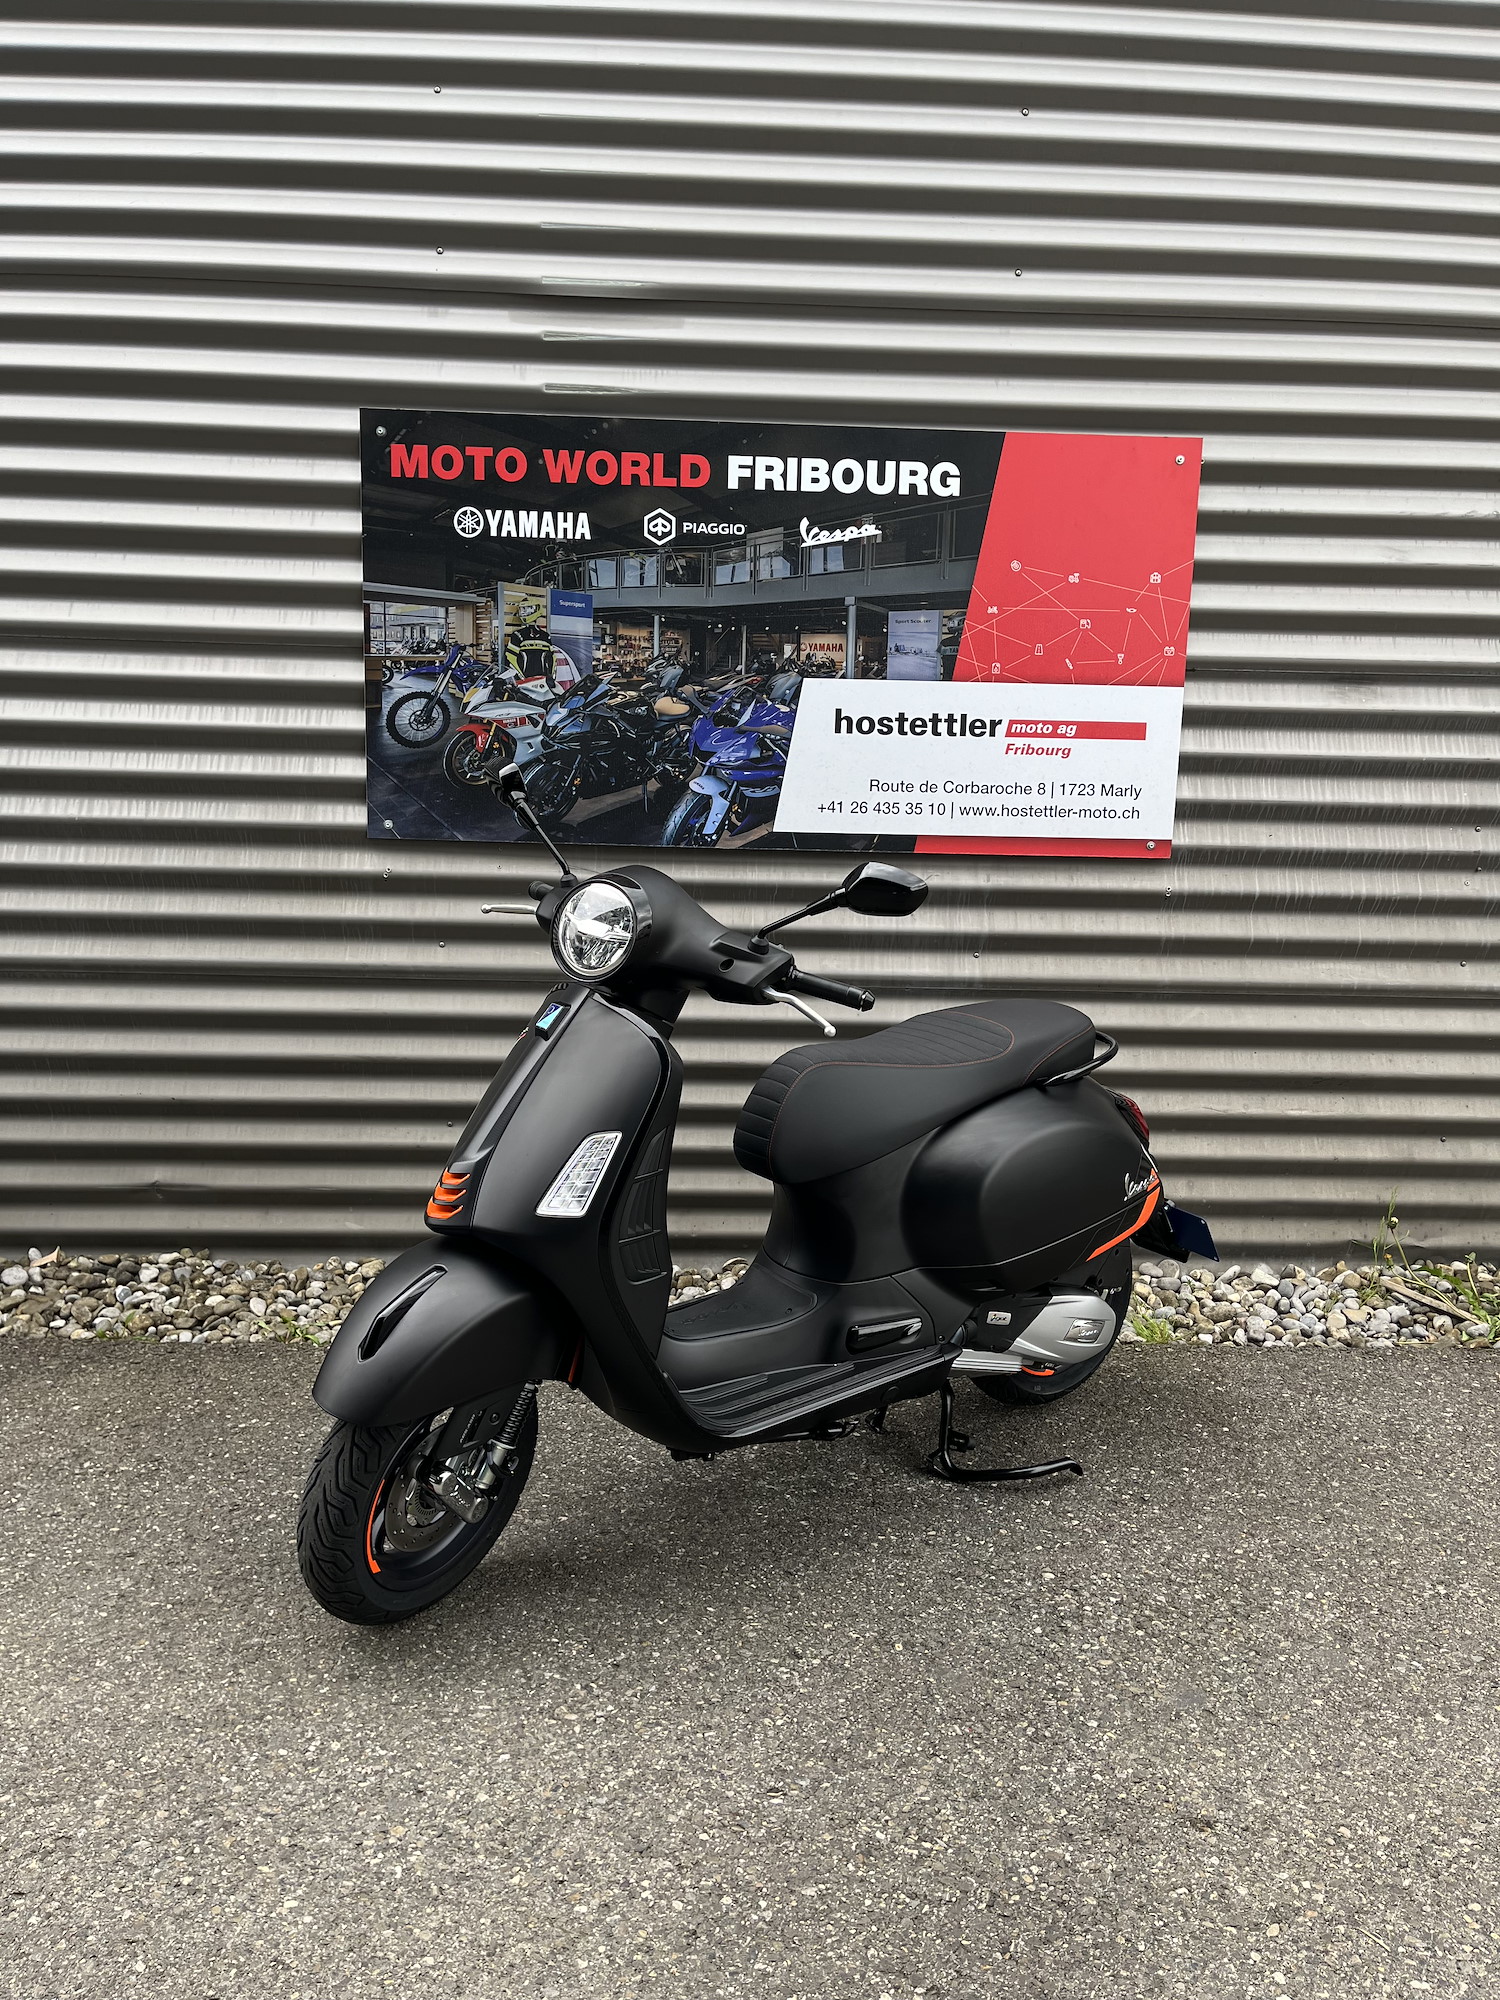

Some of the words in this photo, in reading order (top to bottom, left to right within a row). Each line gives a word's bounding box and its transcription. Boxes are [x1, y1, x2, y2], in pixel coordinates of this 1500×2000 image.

[390, 443, 528, 483] MOTO
[542, 449, 711, 488] WORLD
[727, 455, 961, 498] FRIBOURG
[484, 509, 592, 540] YAMAHA
[682, 522, 745, 535] PIAGGIO
[799, 516, 882, 547] Vespa
[559, 599, 586, 608] Supersport
[807, 643, 844, 653] YAMAHA
[834, 708, 1003, 738] hostettler
[1010, 722, 1053, 734] moto
[1056, 724, 1078, 737] ag
[1004, 743, 1072, 759] Fribourg
[869, 778, 915, 793] Route
[919, 780, 939, 794] de
[943, 780, 1033, 796] Corbaroche
[1036, 782, 1047, 796] 8
[1059, 783, 1096, 797] 1723
[1100, 783, 1143, 801] Marly
[817, 800, 843, 814] +41
[850, 800, 868, 815] 26
[872, 801, 900, 815] 435
[904, 802, 923, 816] 35
[928, 802, 946, 816] 10
[958, 804, 1141, 820] www.hostettler-moto.ch
